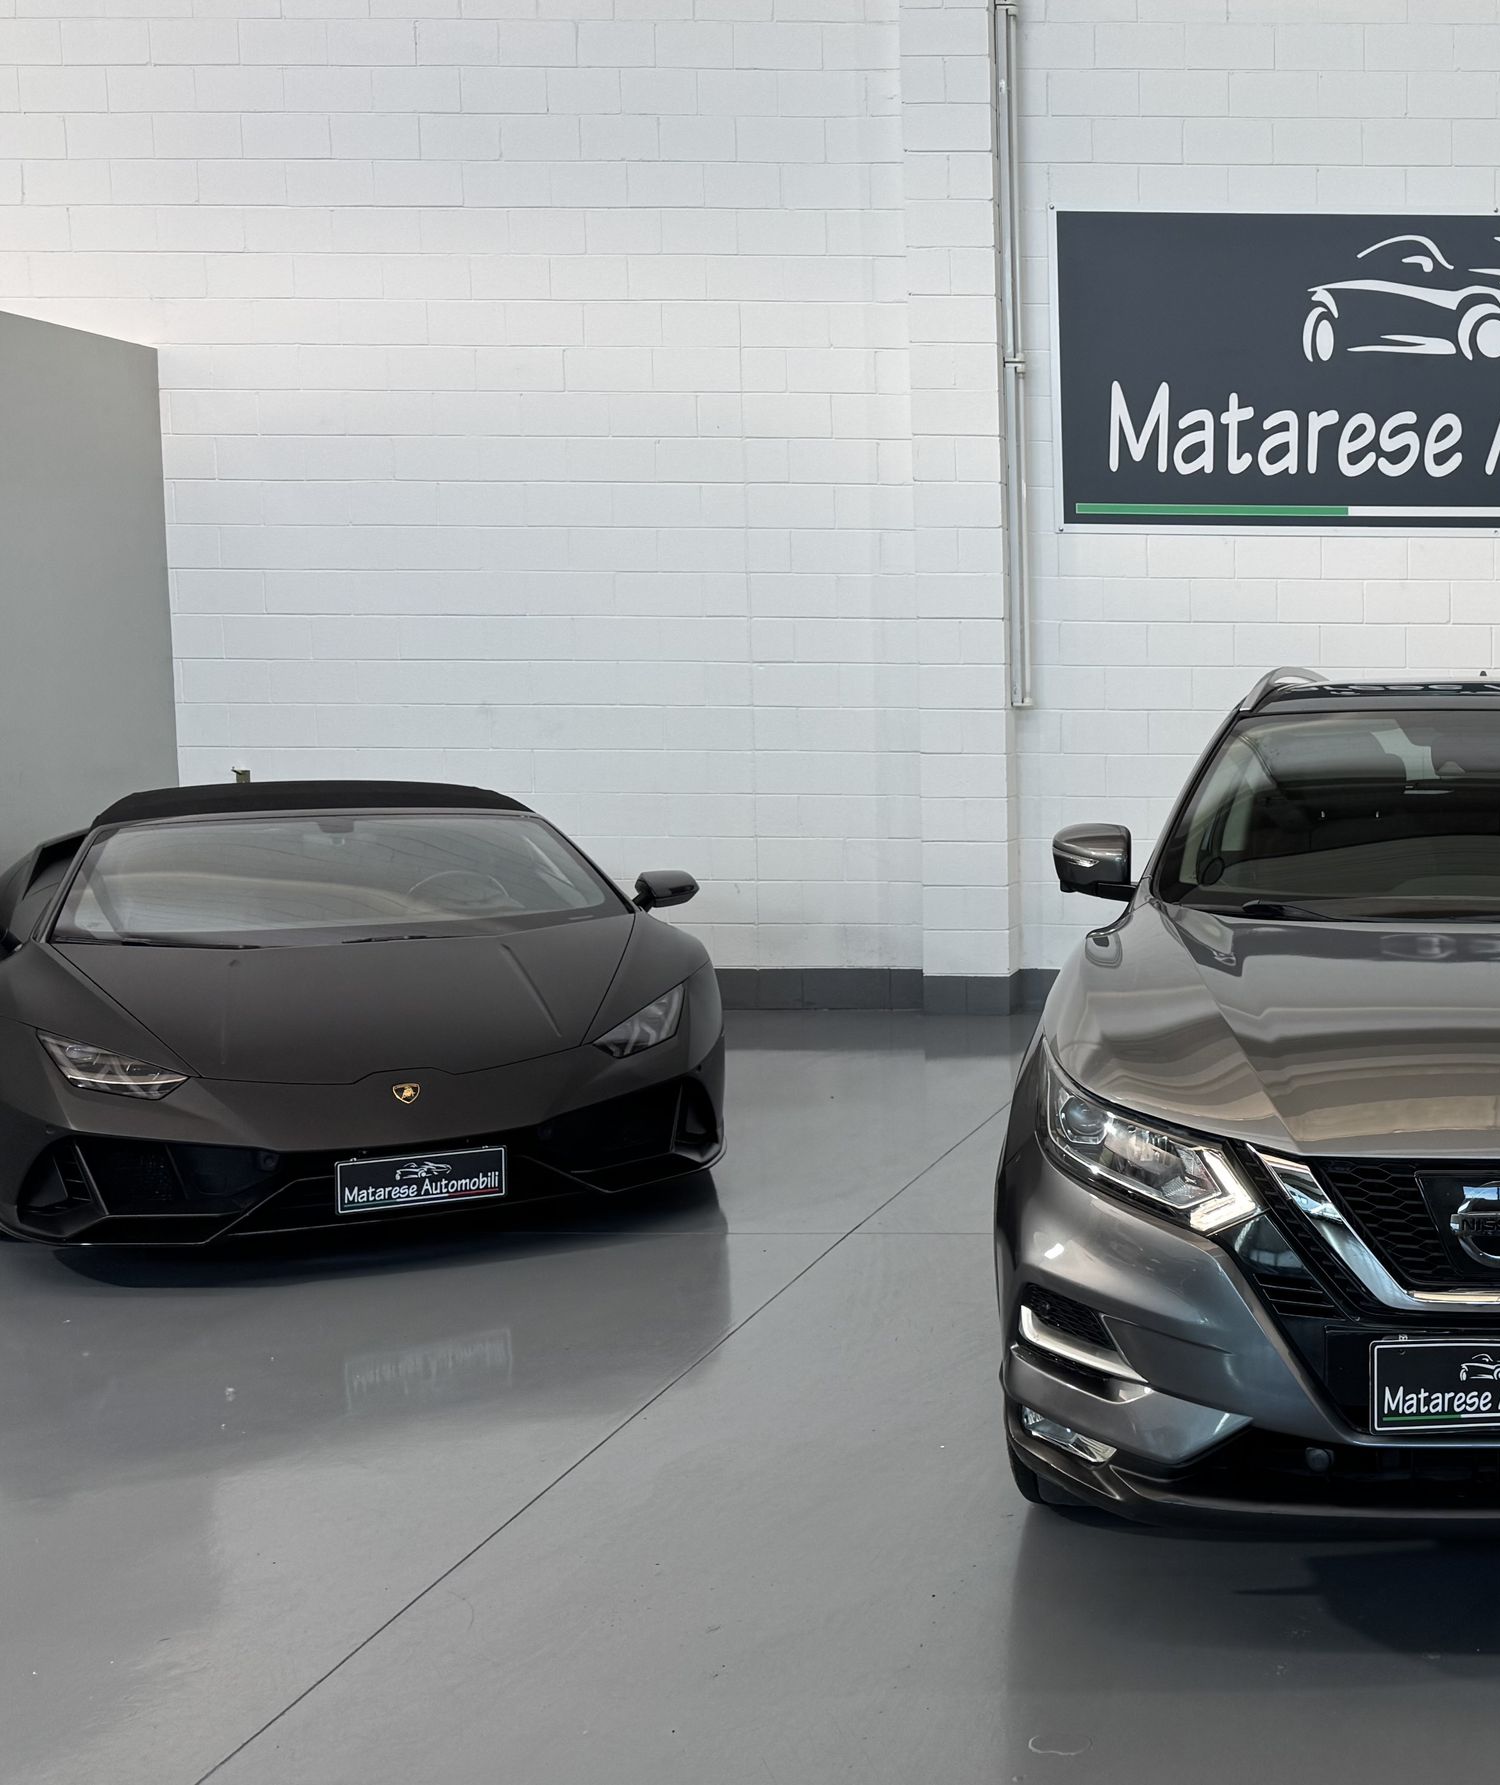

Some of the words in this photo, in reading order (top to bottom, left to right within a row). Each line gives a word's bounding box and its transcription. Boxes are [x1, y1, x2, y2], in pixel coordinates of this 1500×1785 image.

[1108, 380, 1464, 478] Matarese
[344, 1184, 418, 1203] Matarese
[421, 1172, 499, 1195] Automobili
[1383, 1386, 1492, 1414] Matarese
